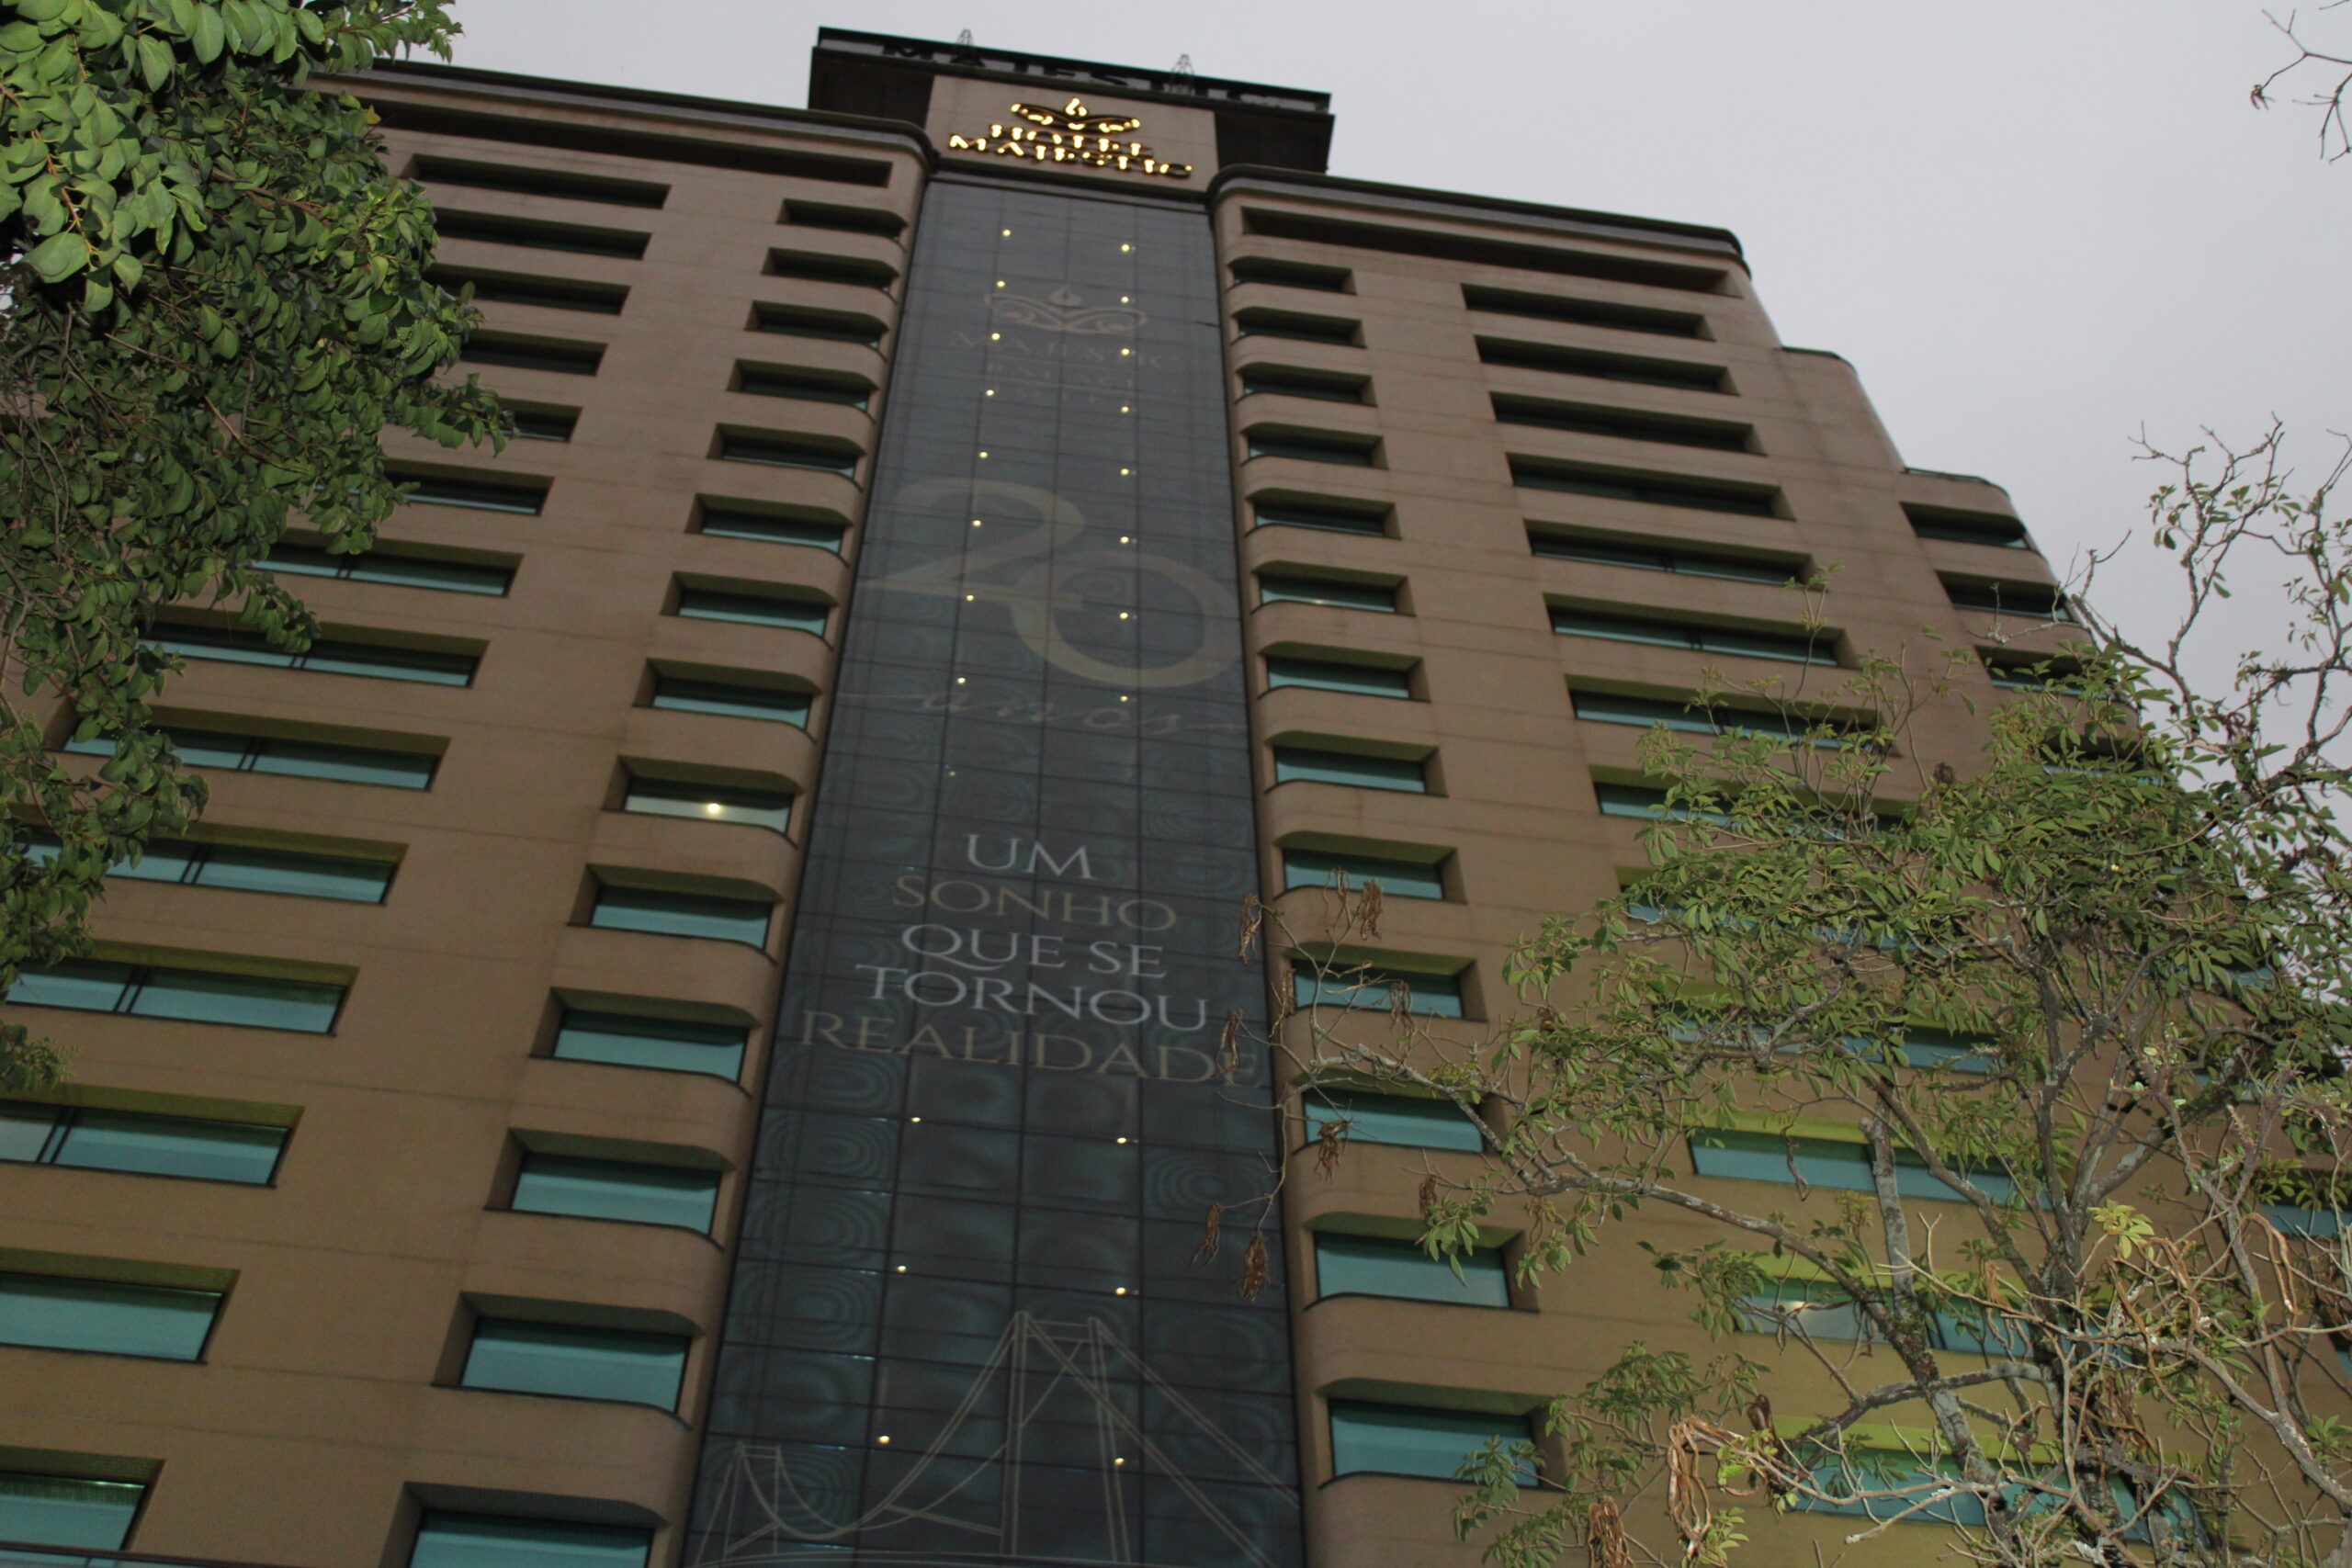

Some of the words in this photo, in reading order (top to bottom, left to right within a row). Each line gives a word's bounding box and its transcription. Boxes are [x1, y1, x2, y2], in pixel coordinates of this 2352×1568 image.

[949, 134, 1193, 178] MAJESTIC
[989, 124, 1155, 158] HOTEL
[857, 477, 1243, 690] 20
[967, 833, 1098, 880] UM
[892, 875, 1177, 931] SONHO
[901, 923, 1067, 972] QUE
[1088, 942, 1168, 978] SE
[855, 964, 1209, 1032] TORNOU
[801, 1010, 1262, 1088] REALIDADE
